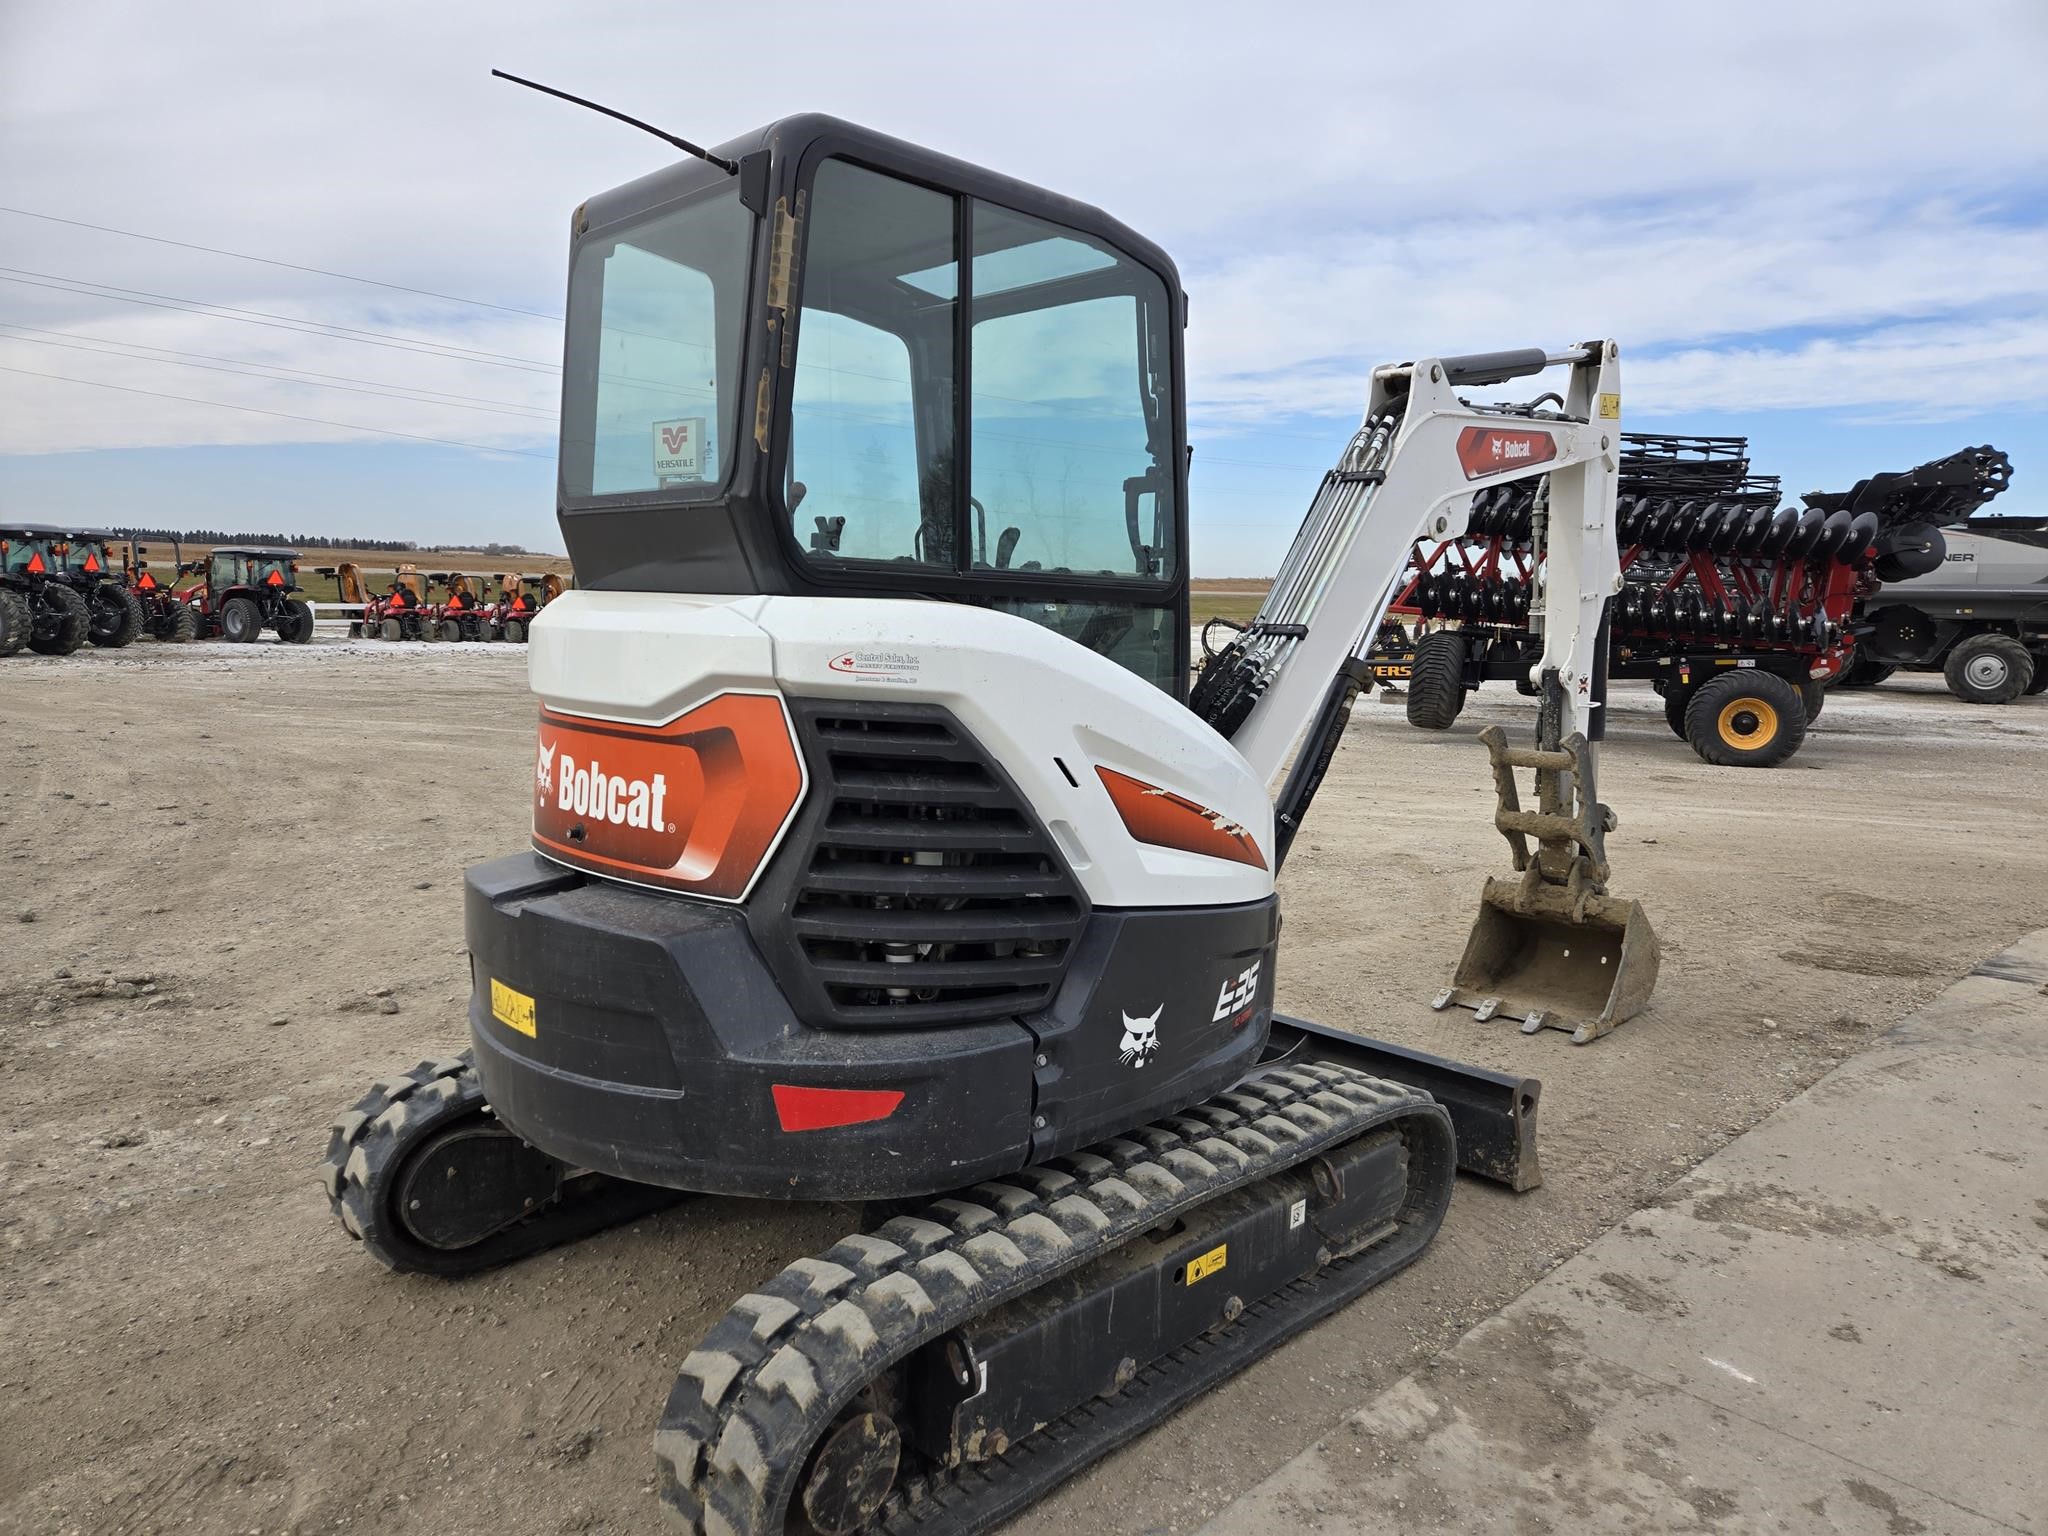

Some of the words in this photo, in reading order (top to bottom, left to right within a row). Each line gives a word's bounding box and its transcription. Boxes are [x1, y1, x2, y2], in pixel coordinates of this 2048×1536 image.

[656, 458, 695, 469] VERSATILE
[1504, 440, 1531, 458] Bobcat
[558, 753, 667, 833] Bobcat
[1211, 959, 1261, 1023] E35
